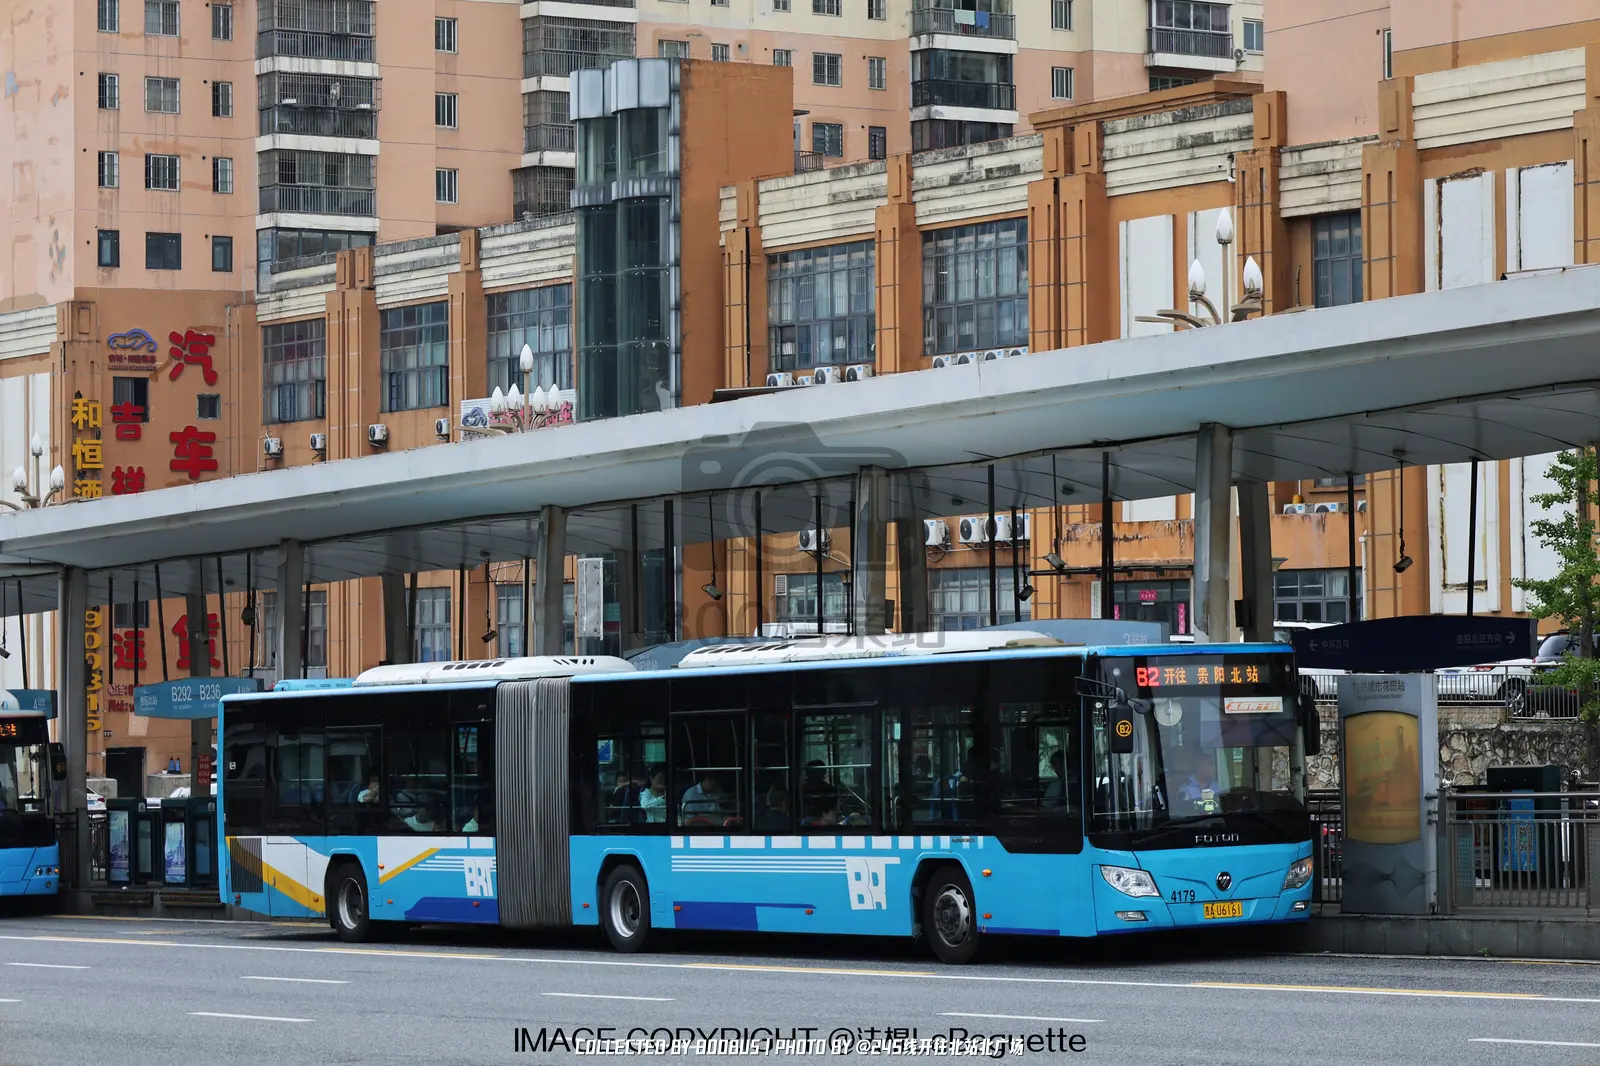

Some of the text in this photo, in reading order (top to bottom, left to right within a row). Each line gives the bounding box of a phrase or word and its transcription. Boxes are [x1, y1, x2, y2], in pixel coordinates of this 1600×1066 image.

[169, 330, 218, 480] 汽车
[111, 402, 145, 495] 吉祥
[113, 631, 147, 669] 运
[1137, 666, 1259, 687] B2 开往 贵阳北站
[171, 686, 193, 702] B292
[200, 684, 221, 701] B236
[1119, 724, 1132, 735] B2
[1195, 833, 1240, 844] FOTON
[463, 856, 494, 897] BRT
[844, 856, 900, 910] BRT
[1170, 889, 1196, 902] 4179
